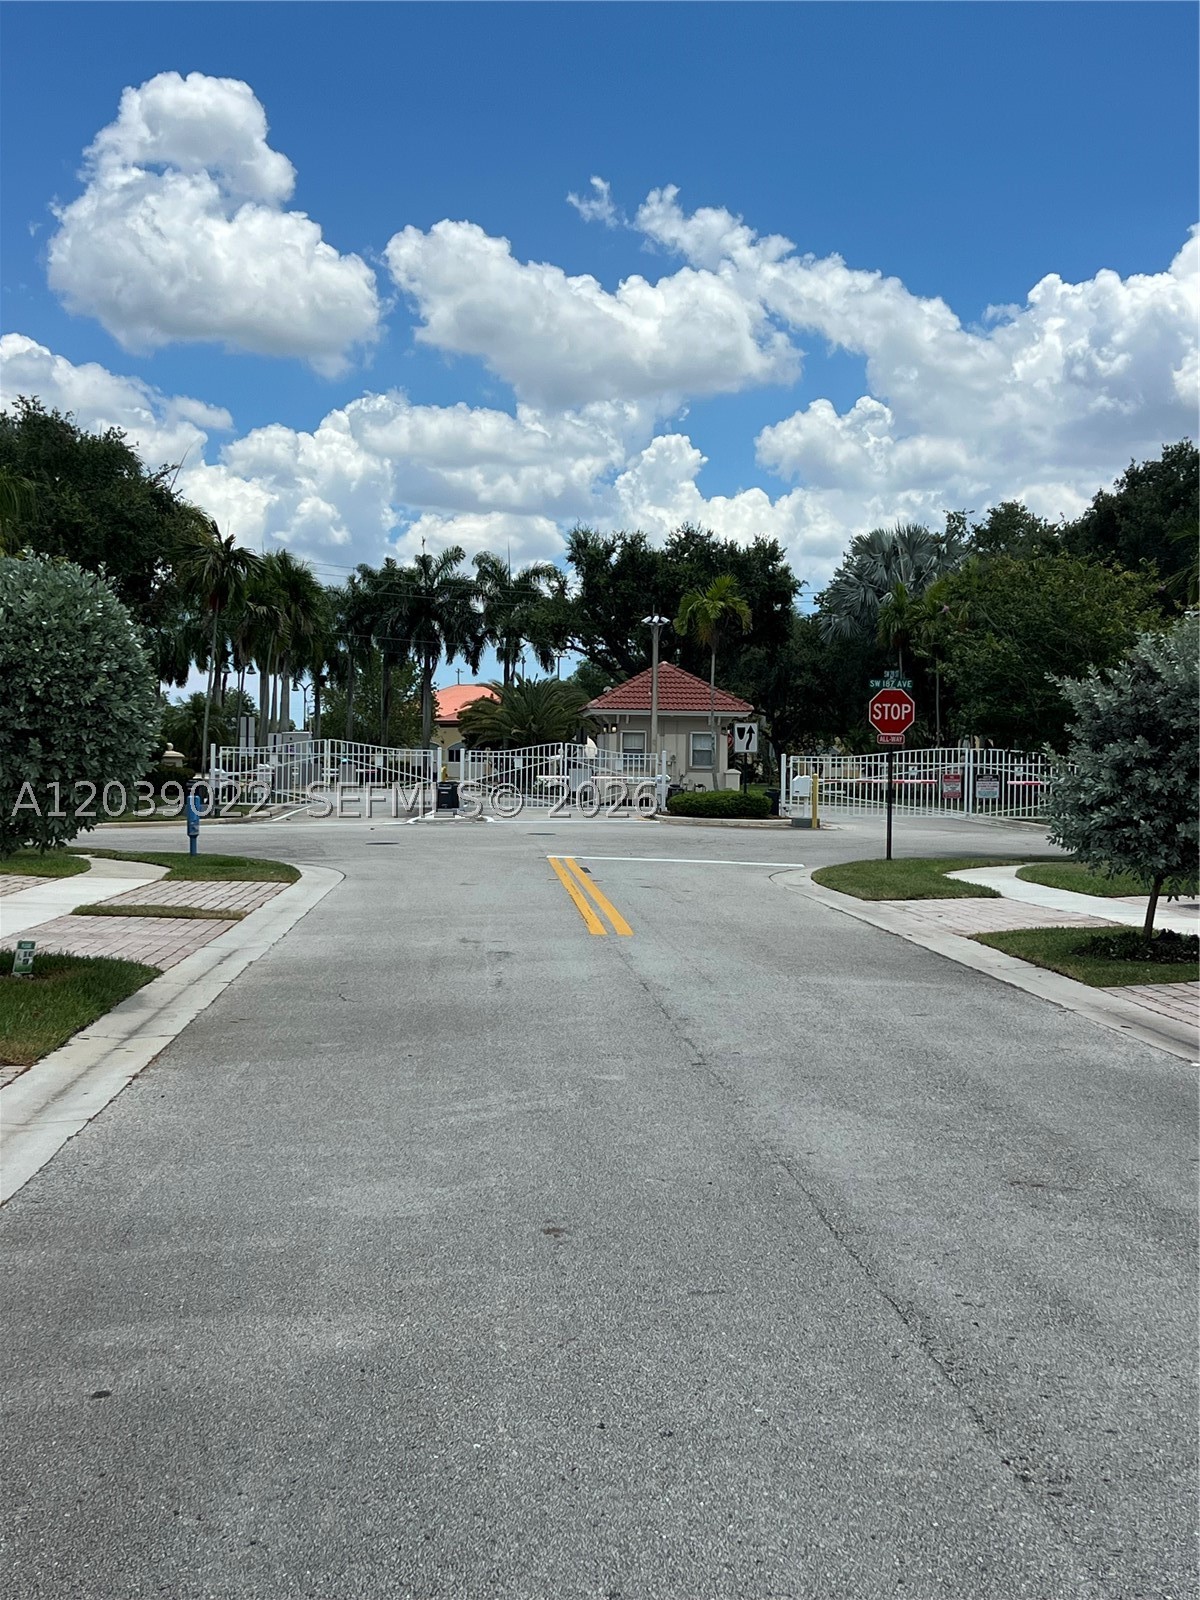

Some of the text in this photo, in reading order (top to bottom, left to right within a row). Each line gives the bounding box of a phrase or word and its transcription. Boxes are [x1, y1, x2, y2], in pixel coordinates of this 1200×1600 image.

[870, 680, 881, 688] SW
[896, 680, 912, 688] AVE
[872, 703, 912, 720] STOP
